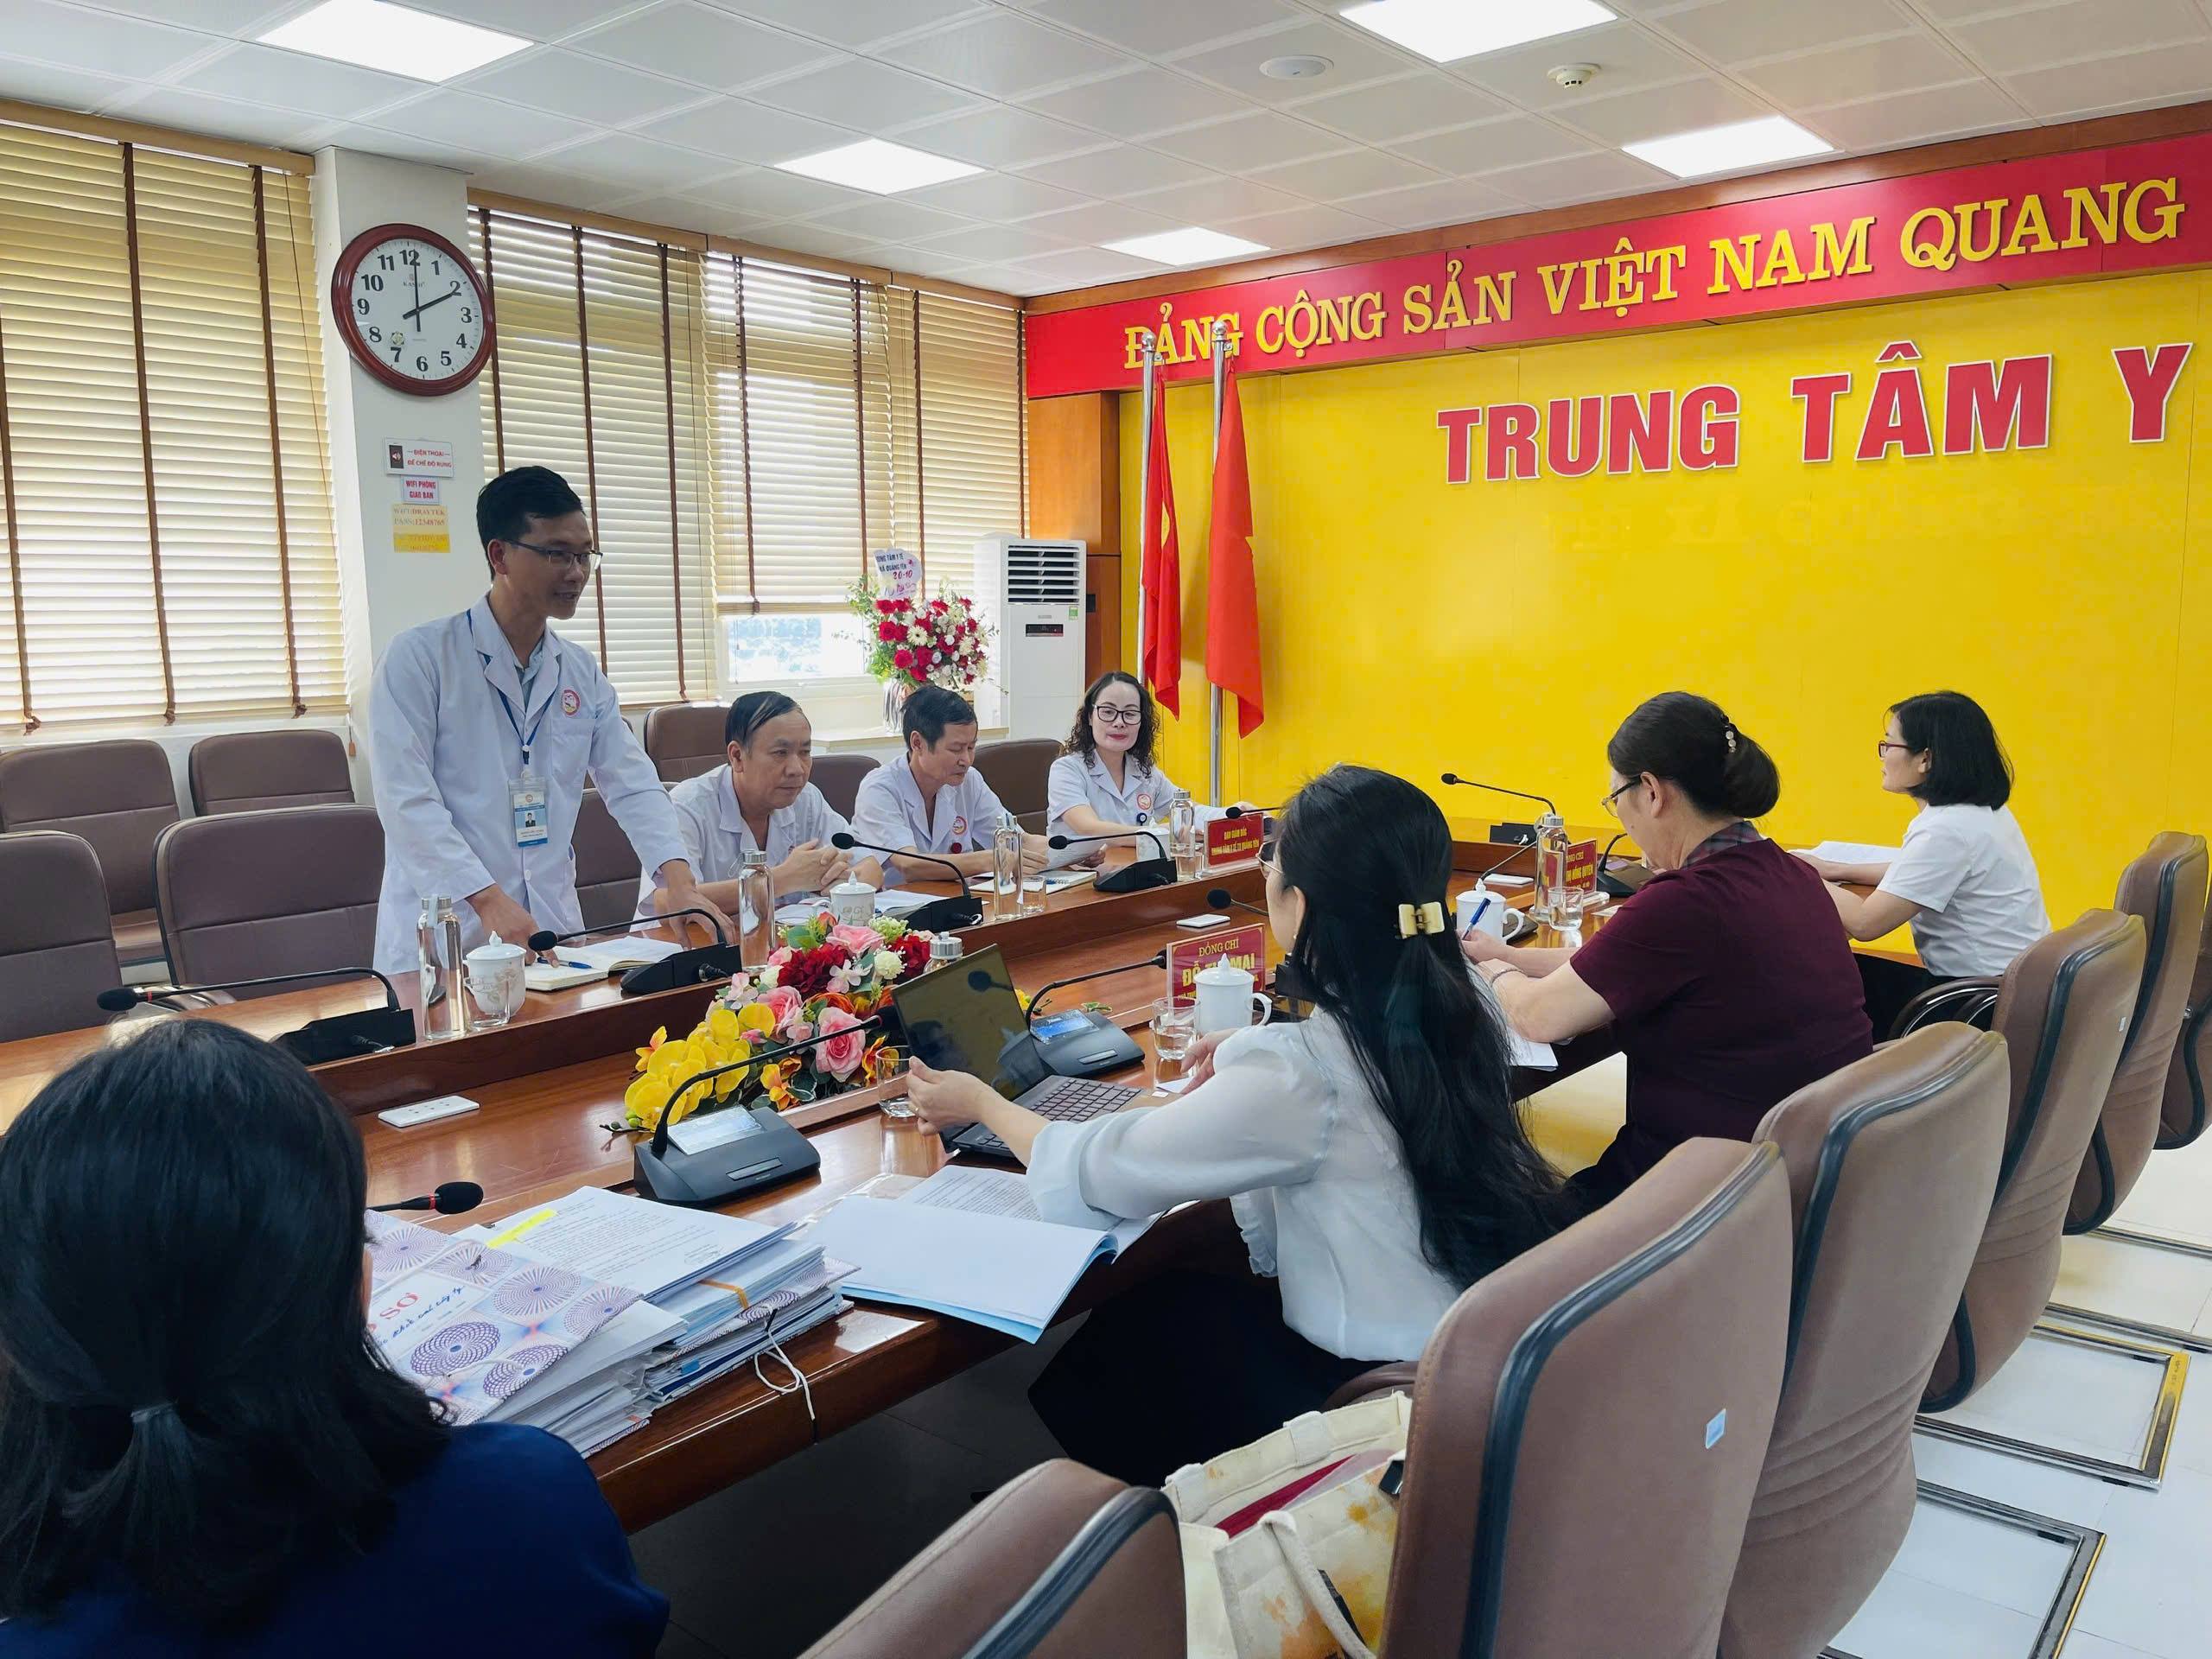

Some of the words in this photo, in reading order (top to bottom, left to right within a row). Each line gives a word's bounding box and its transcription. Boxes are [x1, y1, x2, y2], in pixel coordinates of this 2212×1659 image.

[378, 254, 395, 271] 11
[399, 249, 421, 266] 12
[431, 260, 440, 276] 1
[1124, 302, 1243, 369] ĐẢNG
[1255, 290, 1386, 358] CỘNG
[1403, 259, 1516, 334] SẢN
[1537, 237, 1686, 317] VIỆT
[1707, 216, 1876, 295] NAM
[1900, 177, 2185, 271] QUANG
[361, 274, 384, 292] 10
[449, 281, 462, 296] 2
[357, 298, 370, 315] 9
[461, 307, 473, 323] 3
[369, 326, 382, 343] 8
[456, 334, 467, 349] 4
[390, 346, 402, 363] 7
[441, 351, 452, 366] 5
[416, 356, 429, 372] 6
[1437, 384, 1740, 485] TRUNG
[1790, 340, 2052, 463] TÂM
[2112, 342, 2193, 443] Y
[1198, 941, 1224, 957] ĐỒNG
[1224, 937, 1239, 950] CHÍ
